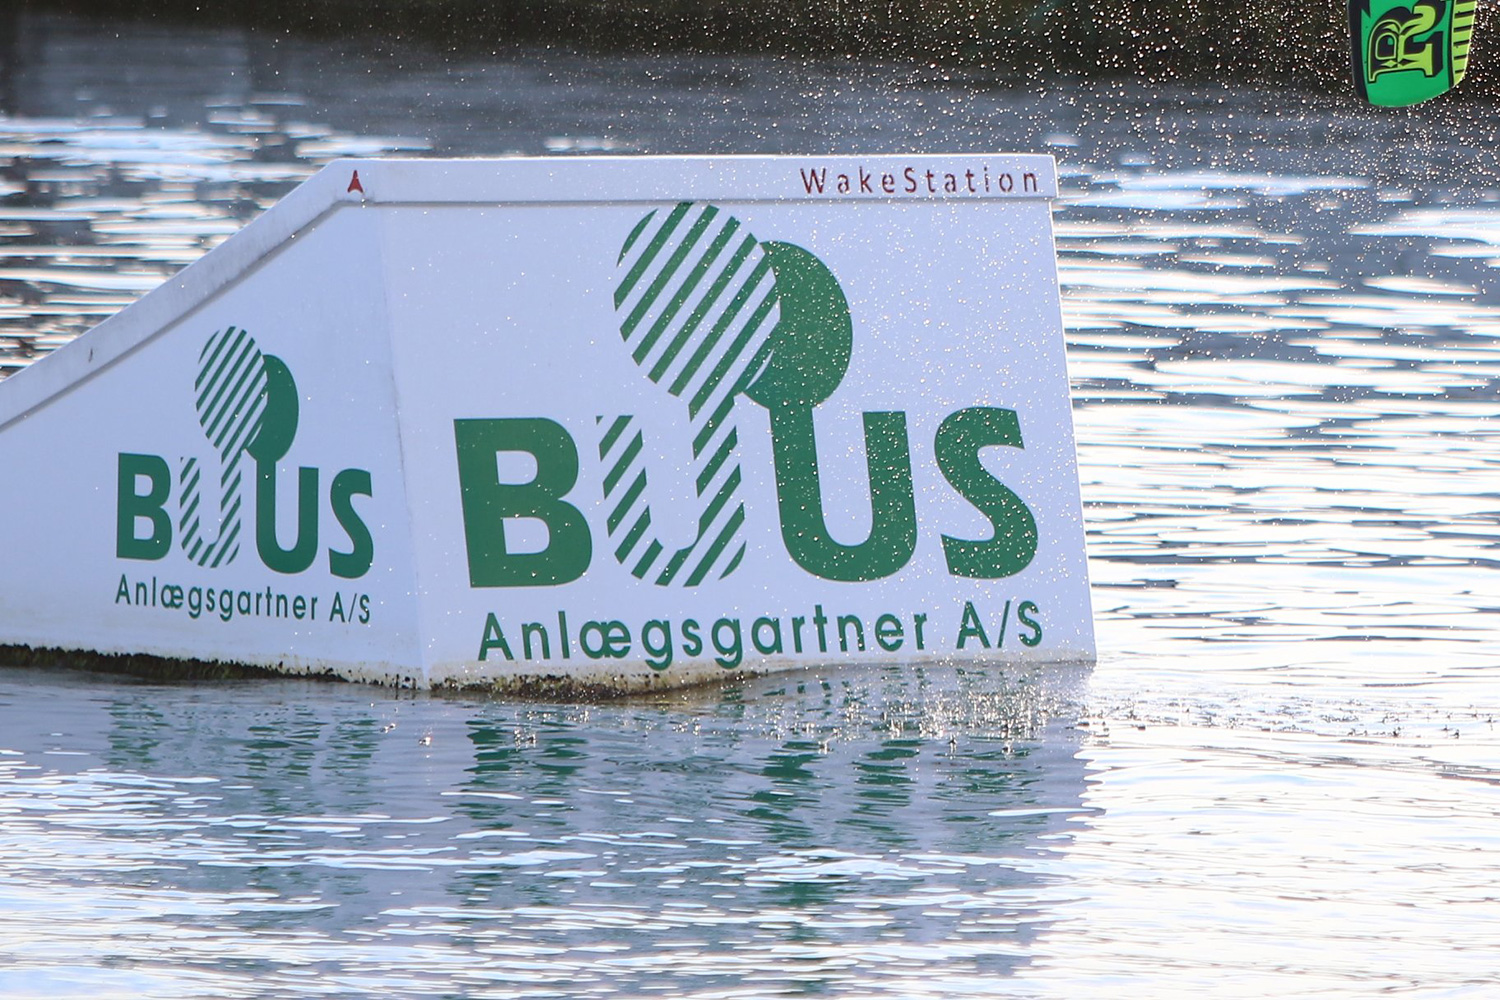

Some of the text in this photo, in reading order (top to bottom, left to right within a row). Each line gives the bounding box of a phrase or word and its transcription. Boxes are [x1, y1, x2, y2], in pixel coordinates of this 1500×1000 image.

[799, 166, 1039, 195] WakeStation
[114, 573, 372, 625] Anlægsgartner A/S
[477, 598, 1044, 672] Anlægsgartner A/S
